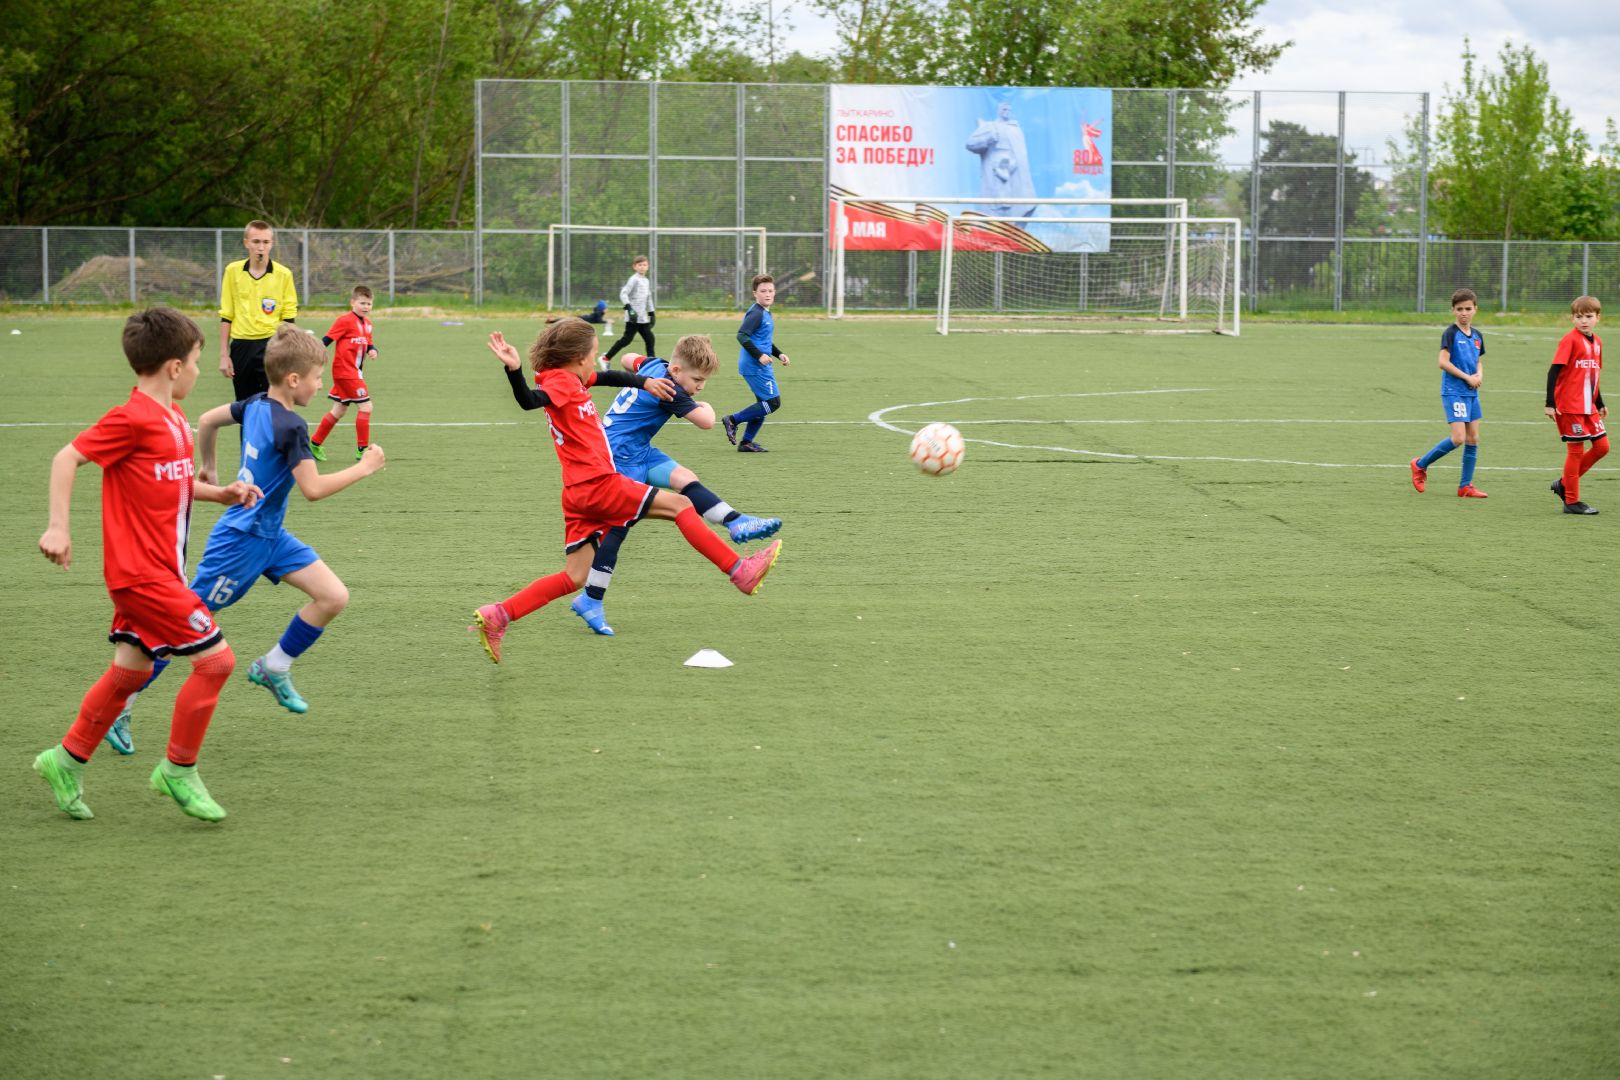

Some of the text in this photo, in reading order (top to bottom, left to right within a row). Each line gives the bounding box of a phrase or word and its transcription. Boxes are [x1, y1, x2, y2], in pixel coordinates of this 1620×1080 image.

[836, 125, 913, 142] СПАСИБО
[836, 147, 934, 167] ЗА ПОБЕДУ!
[853, 222, 886, 237] МАЯ
[207, 575, 239, 605] 15
